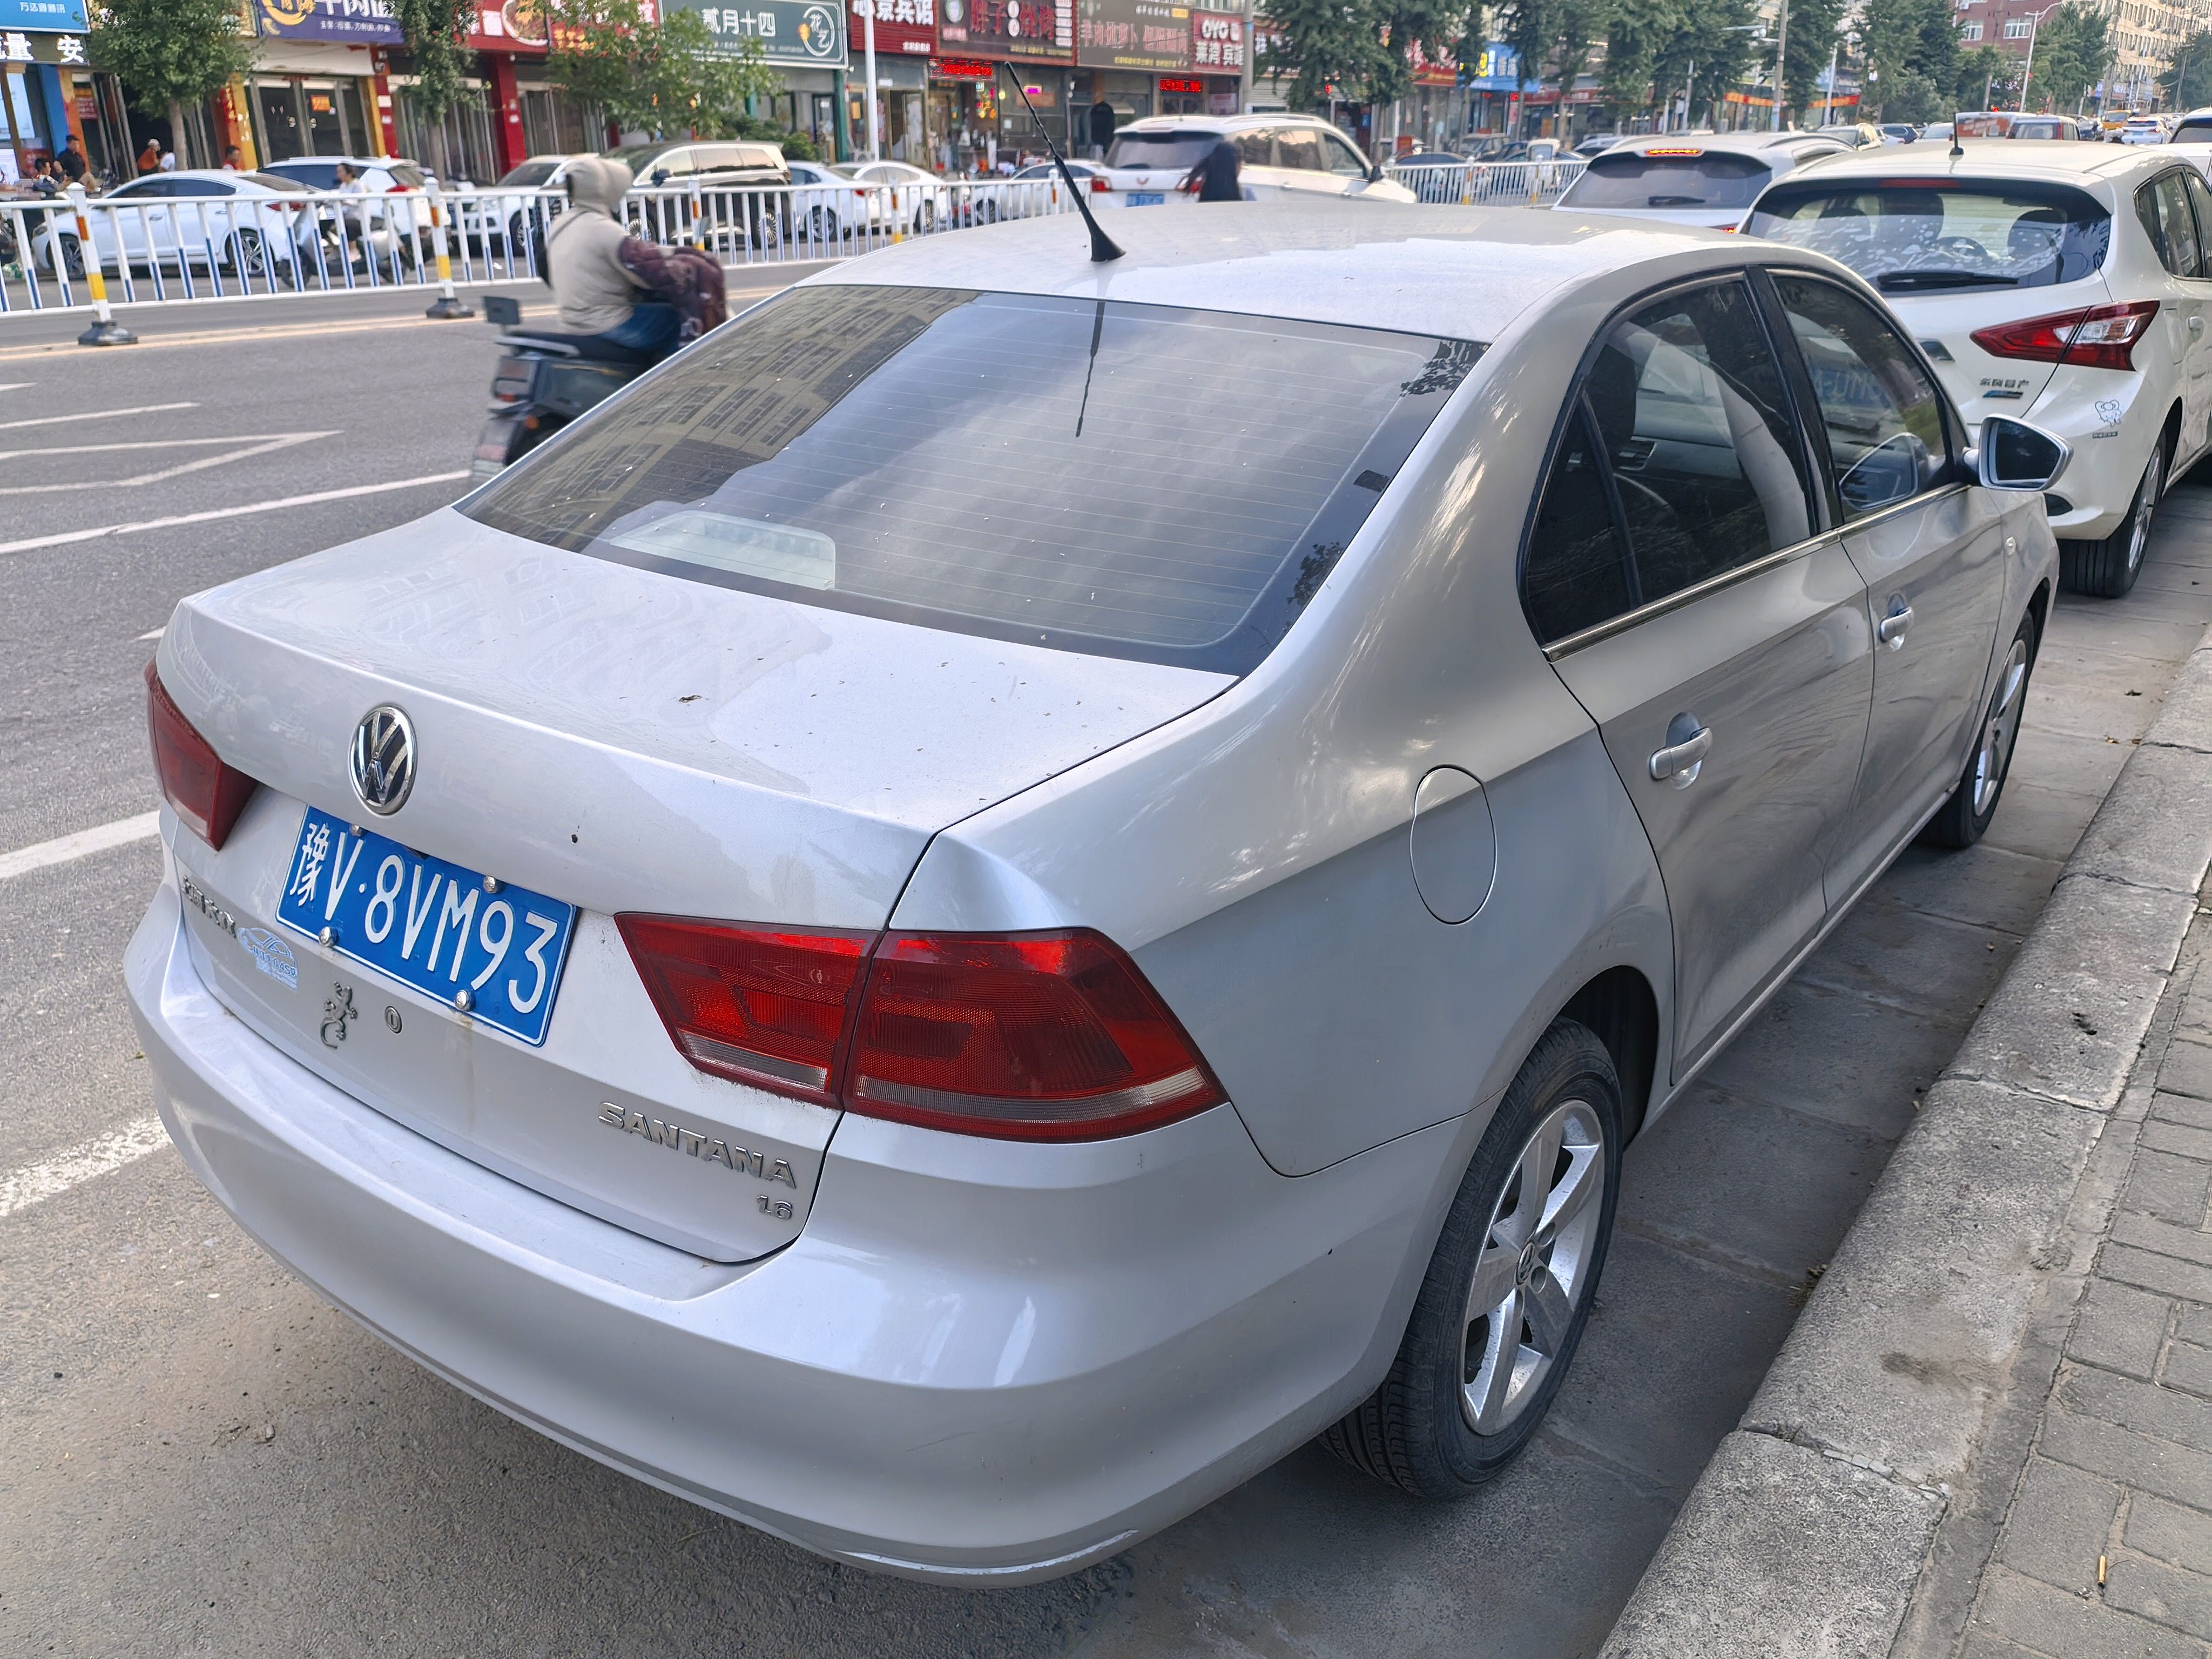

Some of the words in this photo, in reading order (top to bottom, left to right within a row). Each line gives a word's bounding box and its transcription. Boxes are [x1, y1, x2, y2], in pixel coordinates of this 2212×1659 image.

[1980, 378, 2029, 388] 东风日产
[598, 1102, 797, 1189] SANTANA
[757, 1195, 793, 1220] 1.6
